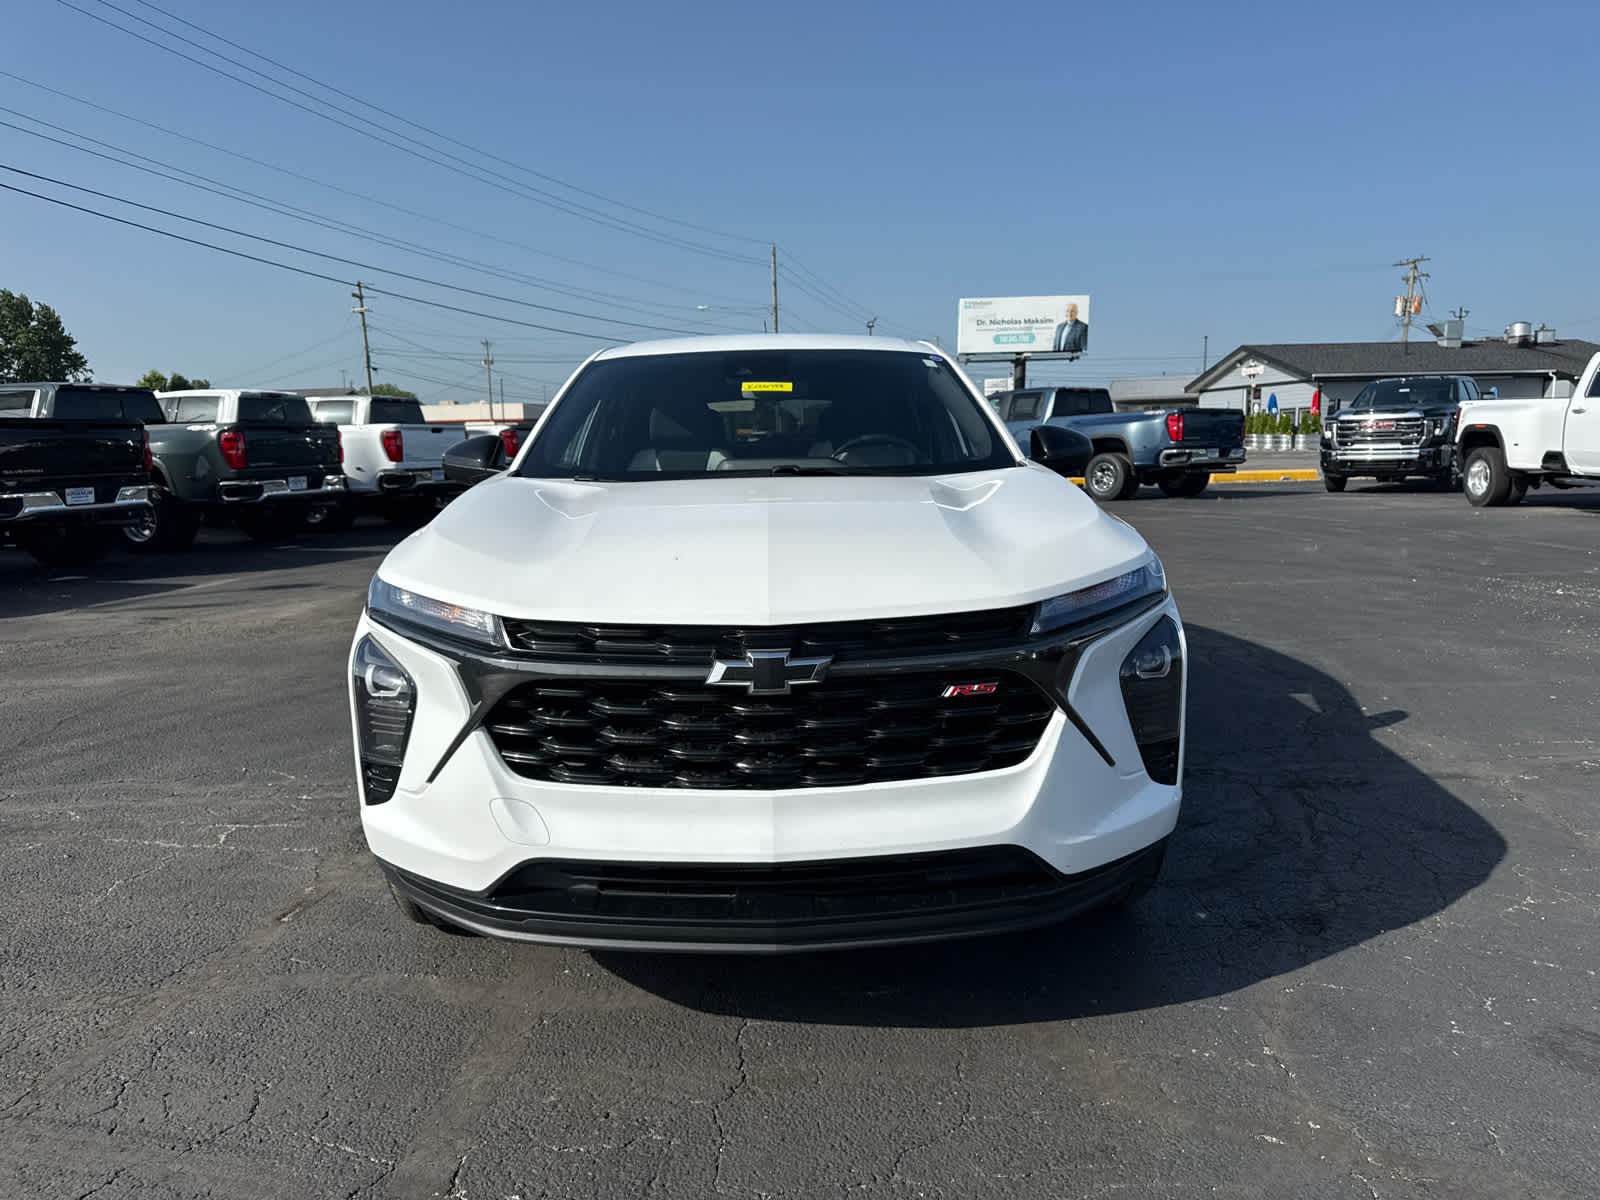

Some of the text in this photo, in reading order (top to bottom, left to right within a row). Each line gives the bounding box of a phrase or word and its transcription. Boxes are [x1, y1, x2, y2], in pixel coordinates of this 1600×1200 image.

[989, 318, 1022, 326] Nicholas
[1024, 317, 1054, 325] Maksim
[944, 682, 998, 697] RS
